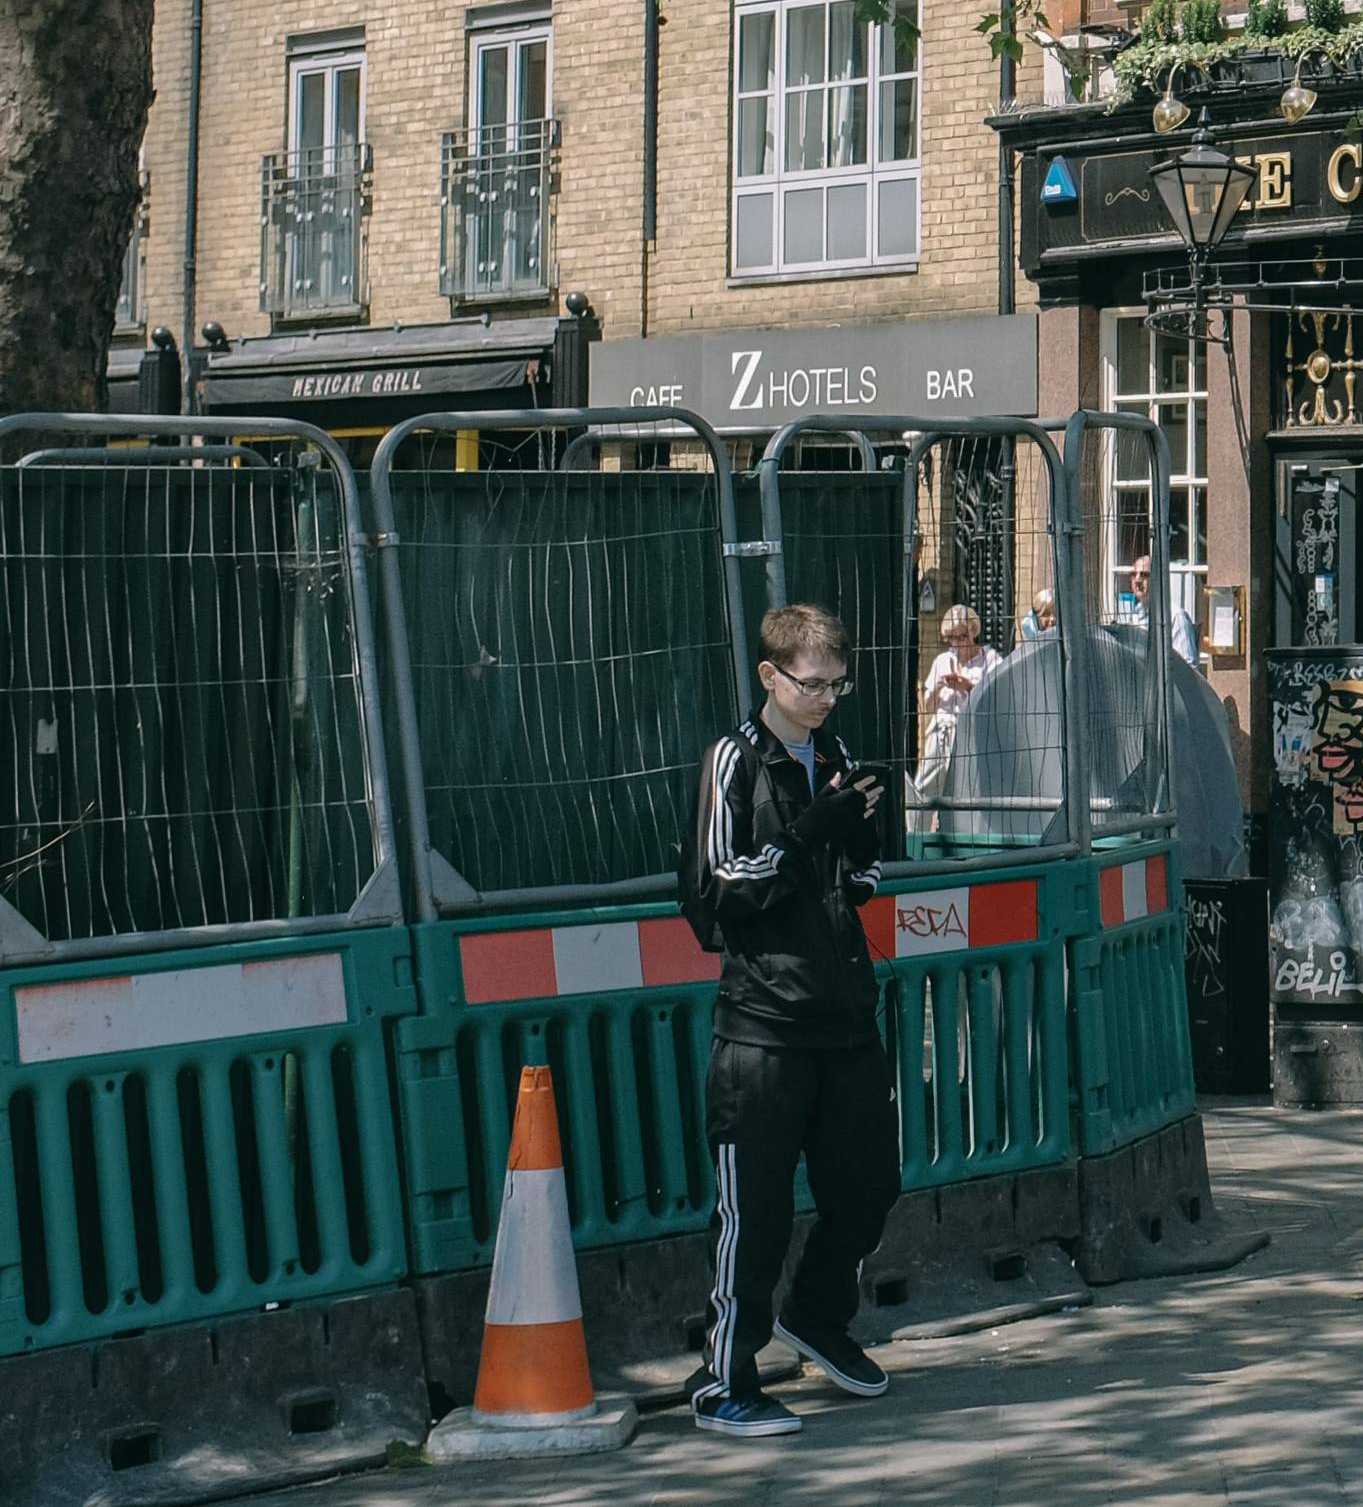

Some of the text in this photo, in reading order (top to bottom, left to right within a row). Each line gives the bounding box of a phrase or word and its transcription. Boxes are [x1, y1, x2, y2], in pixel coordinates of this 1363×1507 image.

[292, 370, 422, 397] MEXICAN GRILL
[729, 350, 877, 411] Z HOTELS
[926, 367, 975, 401] BAR
